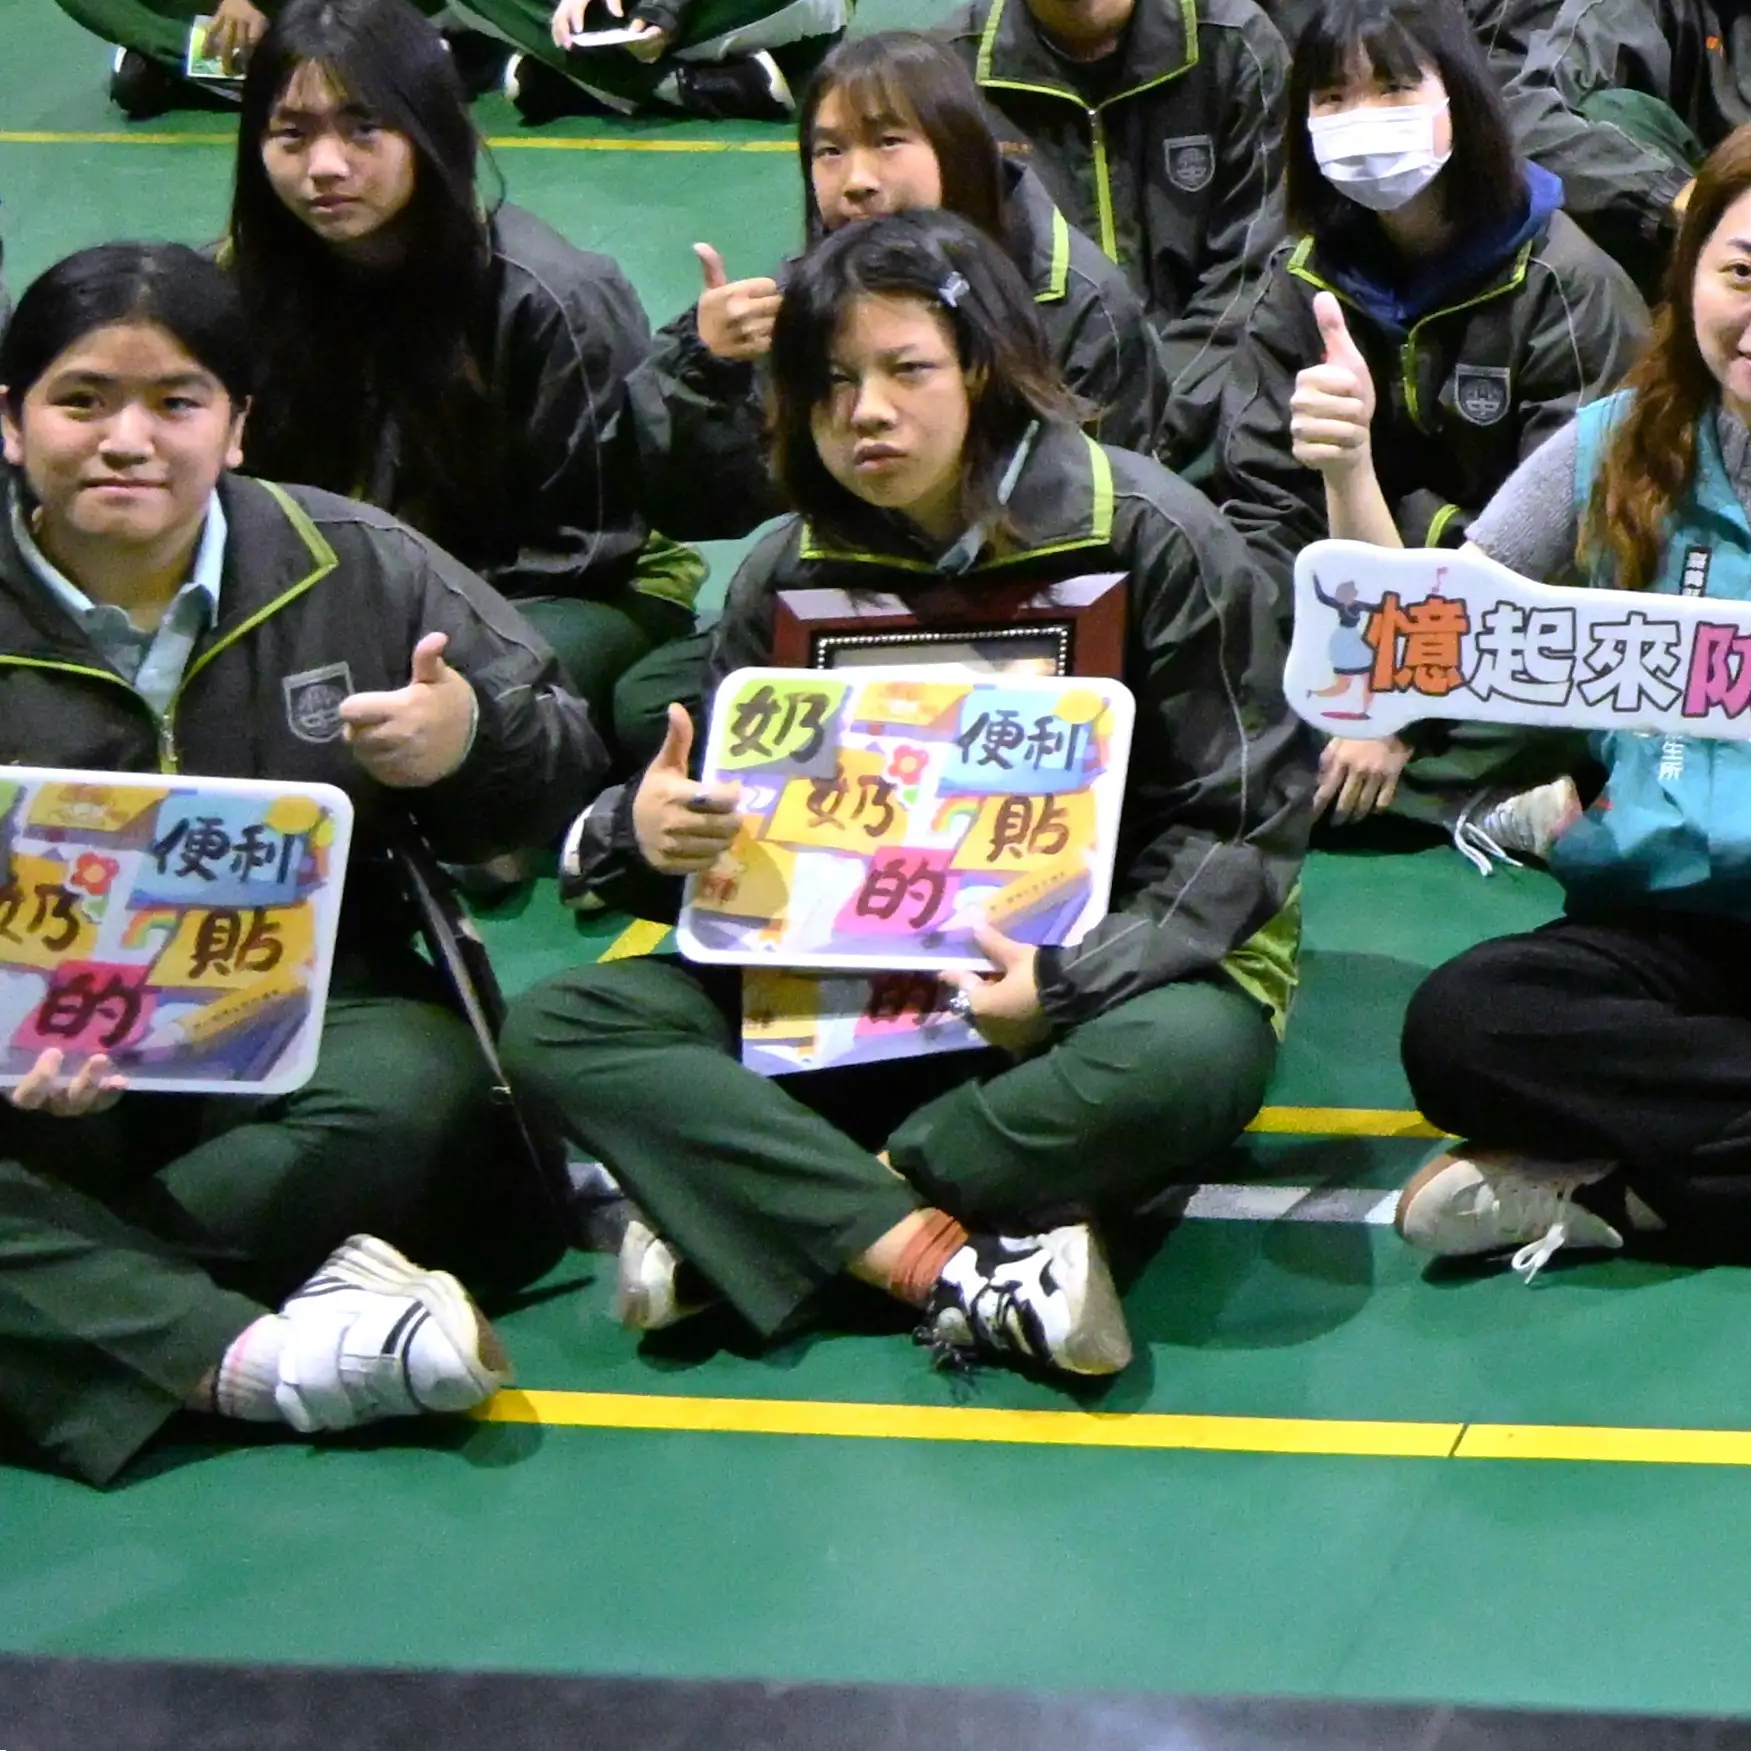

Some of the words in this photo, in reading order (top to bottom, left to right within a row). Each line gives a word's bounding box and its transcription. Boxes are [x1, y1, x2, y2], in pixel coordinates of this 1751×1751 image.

[727, 684, 829, 764] 奶
[956, 709, 1081, 773] 便利
[1657, 735, 1685, 781] 生所
[804, 760, 897, 839] 奶
[986, 792, 1072, 863] 貼
[148, 815, 299, 885] 便利
[855, 855, 947, 930] 的
[187, 905, 285, 980] 貼
[34, 970, 143, 1049] 的
